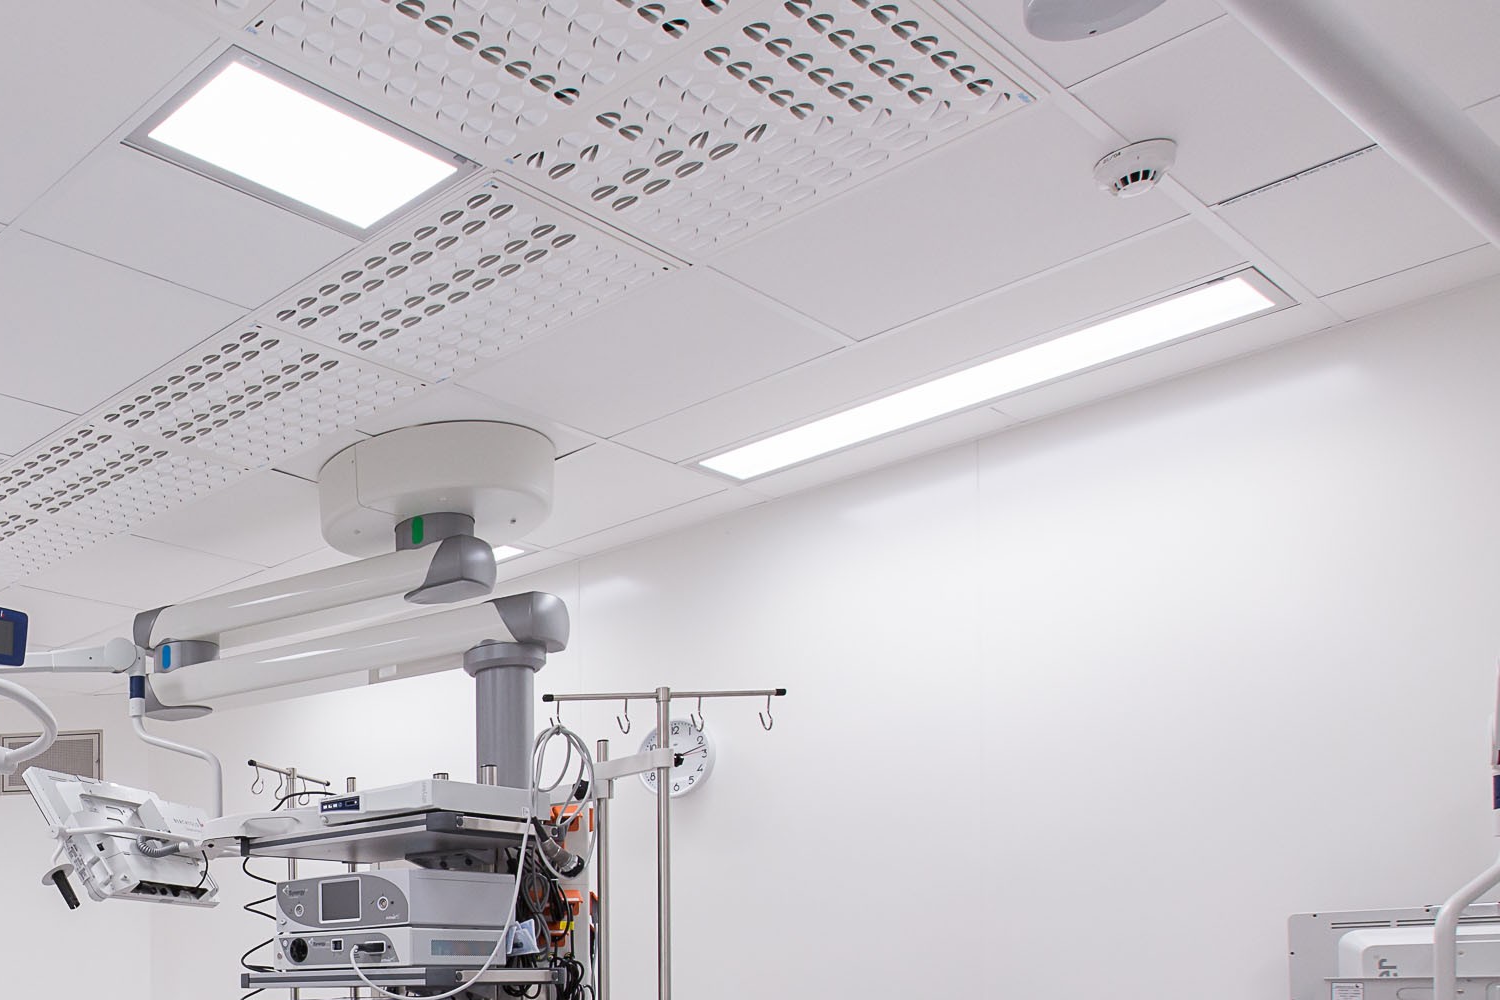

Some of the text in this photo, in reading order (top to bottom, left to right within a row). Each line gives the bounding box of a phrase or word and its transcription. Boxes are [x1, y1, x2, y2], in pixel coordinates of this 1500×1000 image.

[671, 725, 680, 735] 12
[696, 735, 704, 745] 2
[701, 748, 708, 758] 3
[696, 763, 703, 772] 4
[649, 771, 656, 781] 8
[688, 775, 695, 785] 5
[673, 782, 680, 792] 6
